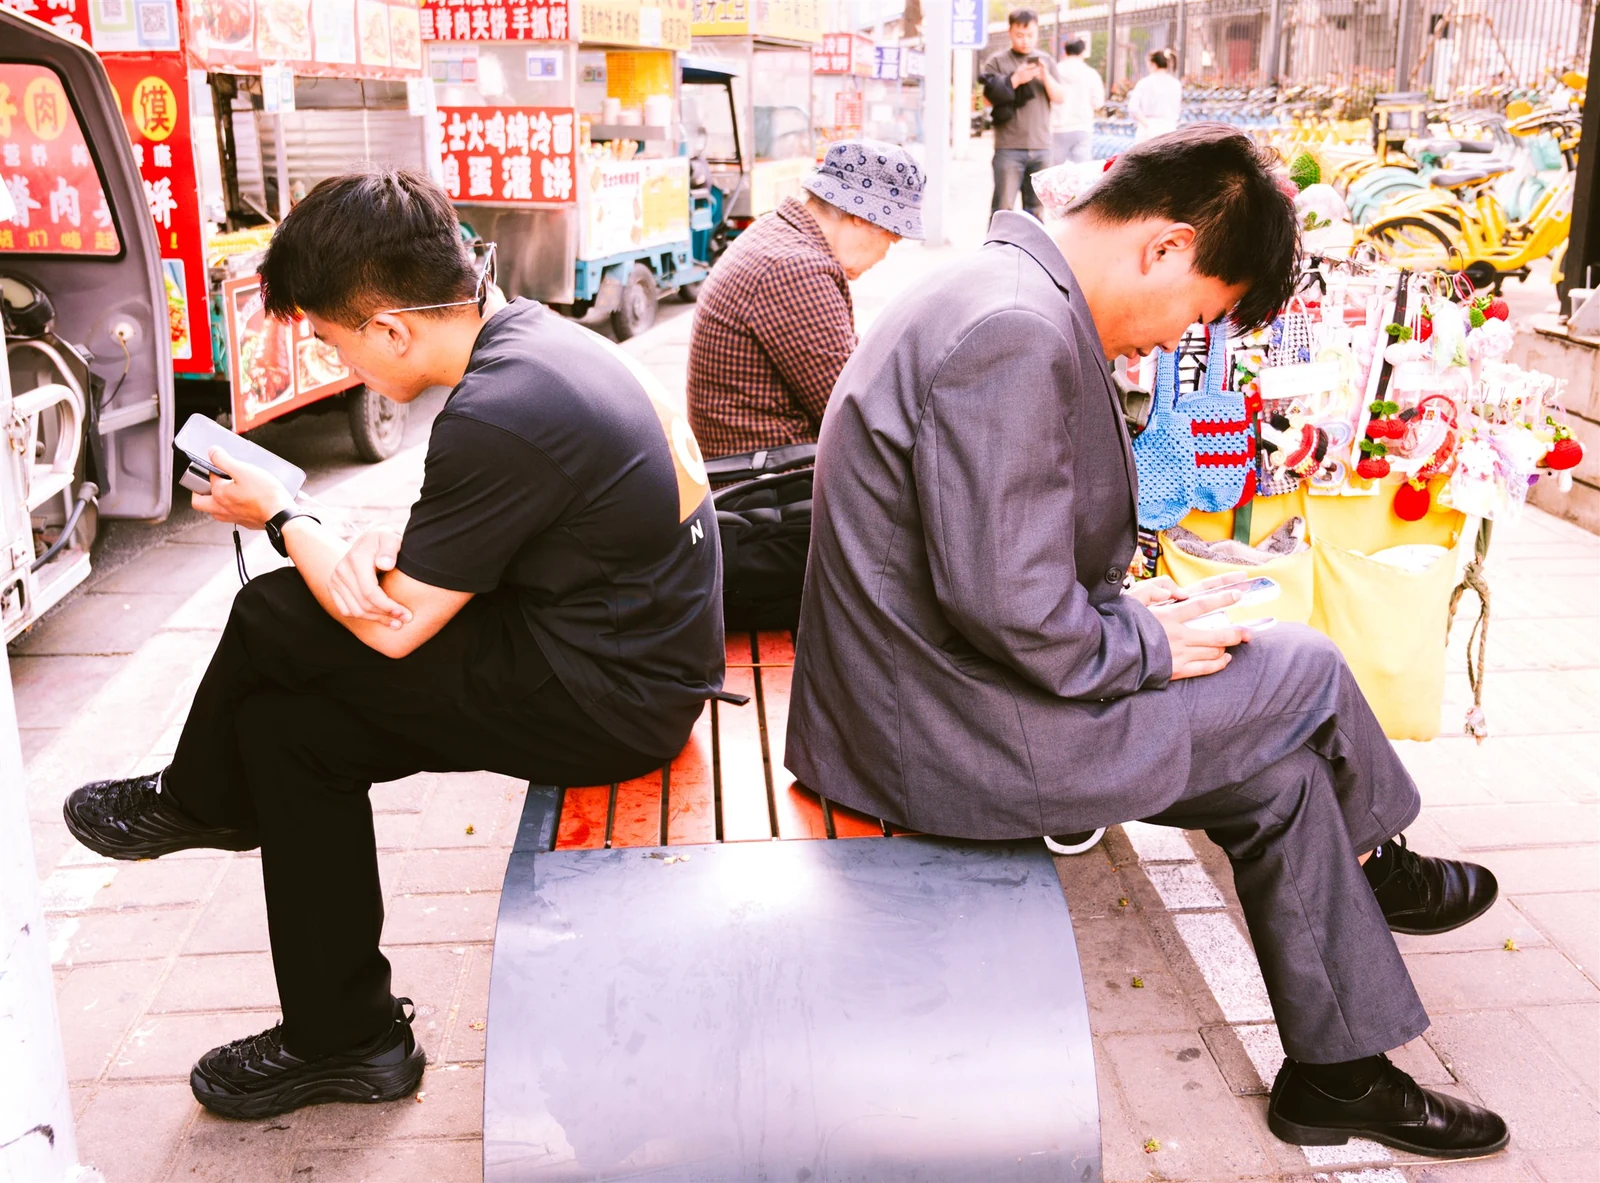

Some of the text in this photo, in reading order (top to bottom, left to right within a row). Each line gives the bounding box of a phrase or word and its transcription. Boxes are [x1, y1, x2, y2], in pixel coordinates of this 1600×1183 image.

[420, 7, 508, 41] 里脊肉夹饼
[511, 6, 568, 41] 手抓饼
[690, 518, 705, 545] N
